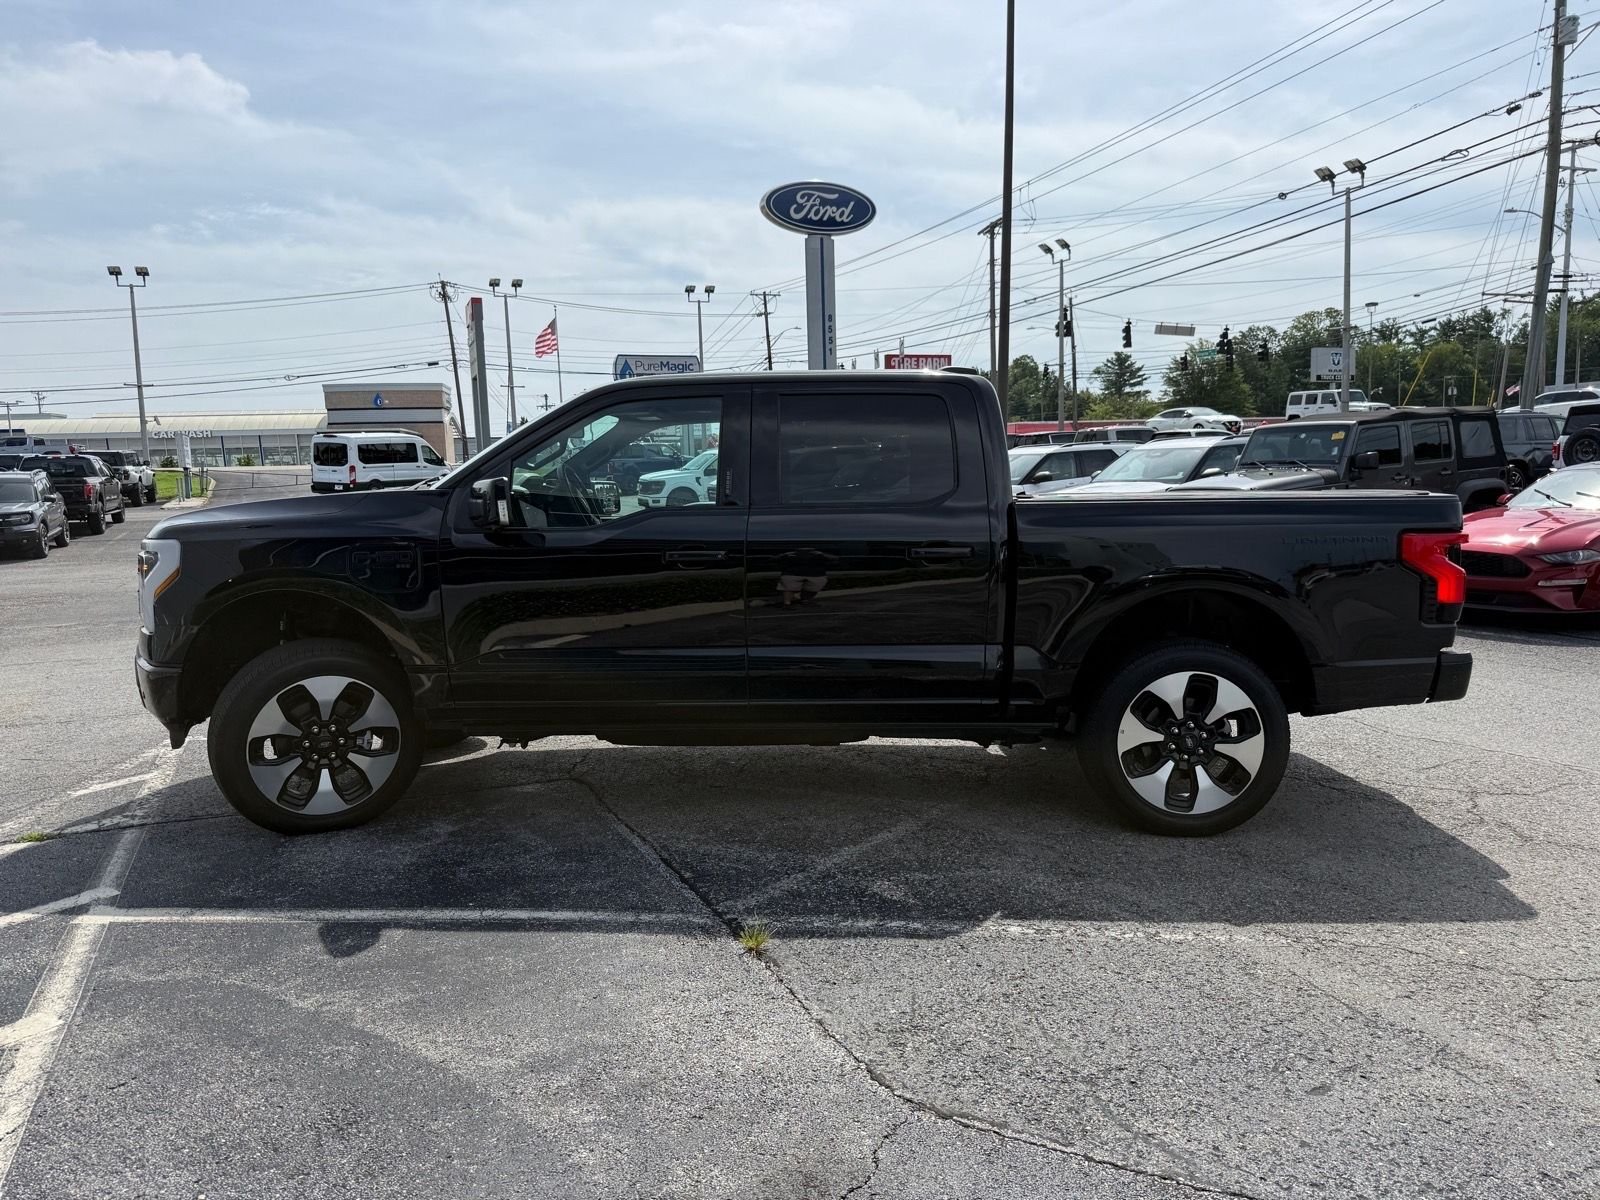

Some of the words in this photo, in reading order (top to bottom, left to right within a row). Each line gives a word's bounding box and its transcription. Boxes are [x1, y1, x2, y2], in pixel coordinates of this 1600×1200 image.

[789, 190, 855, 222] Ford
[634, 360, 695, 374] PureMagic
[152, 430, 176, 439] CAR
